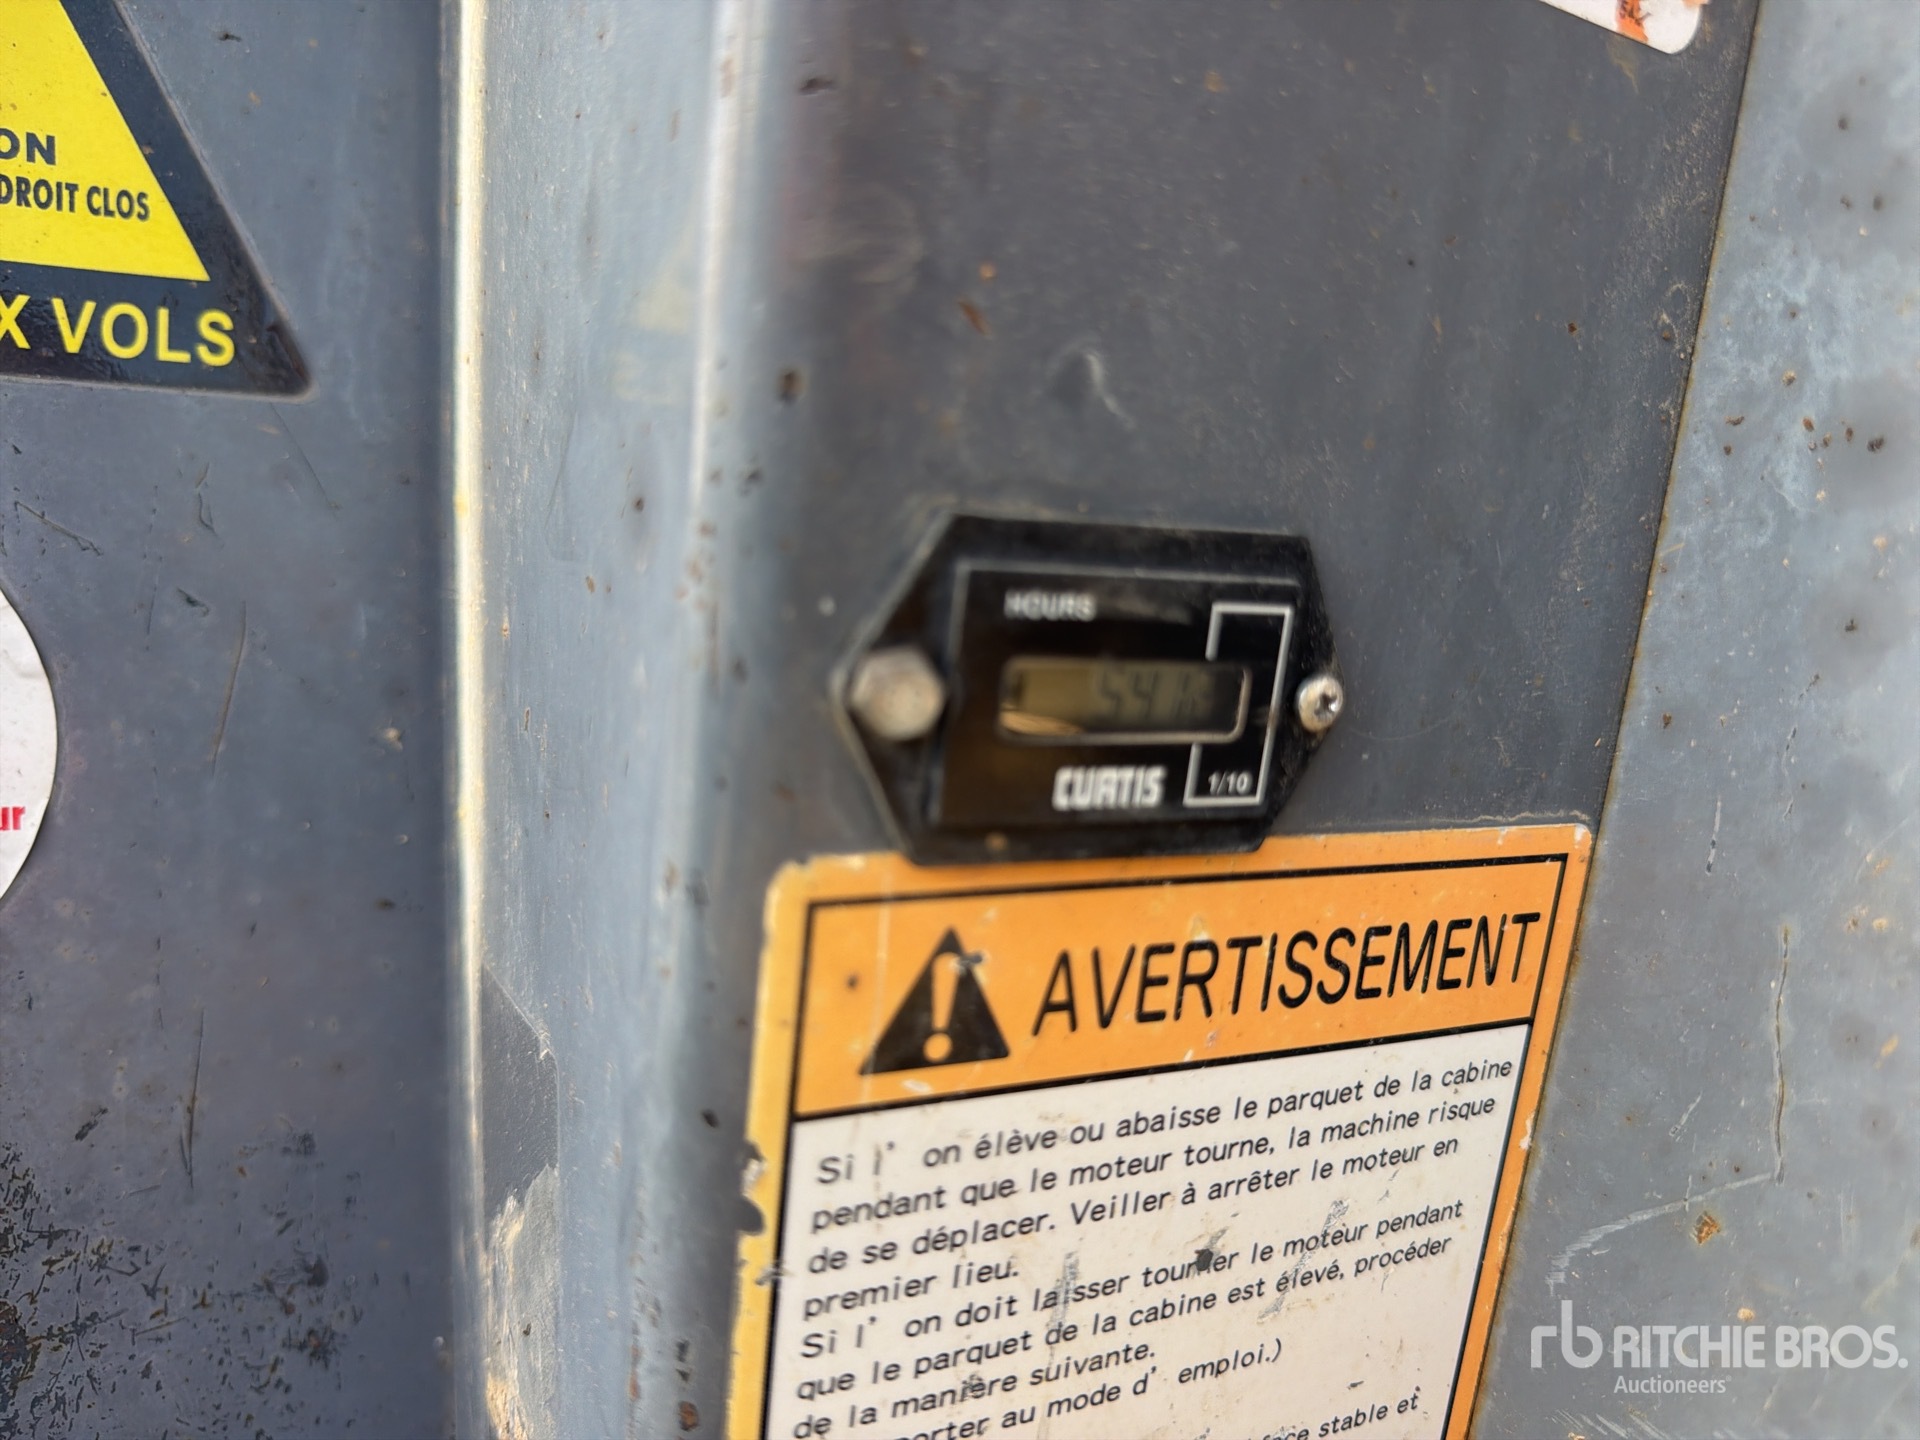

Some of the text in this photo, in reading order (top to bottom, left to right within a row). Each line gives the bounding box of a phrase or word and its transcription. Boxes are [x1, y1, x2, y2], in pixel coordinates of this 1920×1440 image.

[0, 174, 150, 222] DROIT CLOS
[52, 297, 235, 366] VOLS
[1004, 590, 1096, 621] HOURS
[1052, 766, 1166, 811] CURTIS
[1208, 771, 1250, 795] 1/10
[1033, 911, 1542, 1037] AVERTISSEMENT
[811, 1097, 1495, 1234] pendant que le moteur tourne, la machine risque
[818, 1154, 854, 1184] Si
[923, 1144, 961, 1167] on
[975, 1128, 1057, 1159] élève
[1070, 1122, 1104, 1144] ou
[1116, 1106, 1220, 1138] abaisse
[1234, 1096, 1257, 1120] le
[1267, 1080, 1363, 1118] parquet
[1374, 1075, 1400, 1097] de
[1411, 1070, 1431, 1092] la
[1441, 1059, 1512, 1087] cabine
[808, 1137, 1458, 1273] de se déplacer. Veiller à arrêter le moteur en
[797, 1237, 1452, 1401] que le parquet de la cabine est élevé, procéder
[801, 1330, 836, 1358] Si
[904, 1314, 941, 1337] on
[955, 1296, 1017, 1327] doit
[1251, 1242, 1273, 1264] le
[1283, 1223, 1368, 1257] moteur
[1376, 1199, 1463, 1239] pendant
[803, 1259, 1019, 1321] premier lieu.
[793, 1343, 1155, 1439] de la manière suivante.
[1000, 1405, 1035, 1428] au
[1047, 1384, 1121, 1417] mode
[1178, 1338, 1282, 1384] emploi.)
[1318, 1403, 1388, 1438] stable
[1396, 1393, 1419, 1414] et
